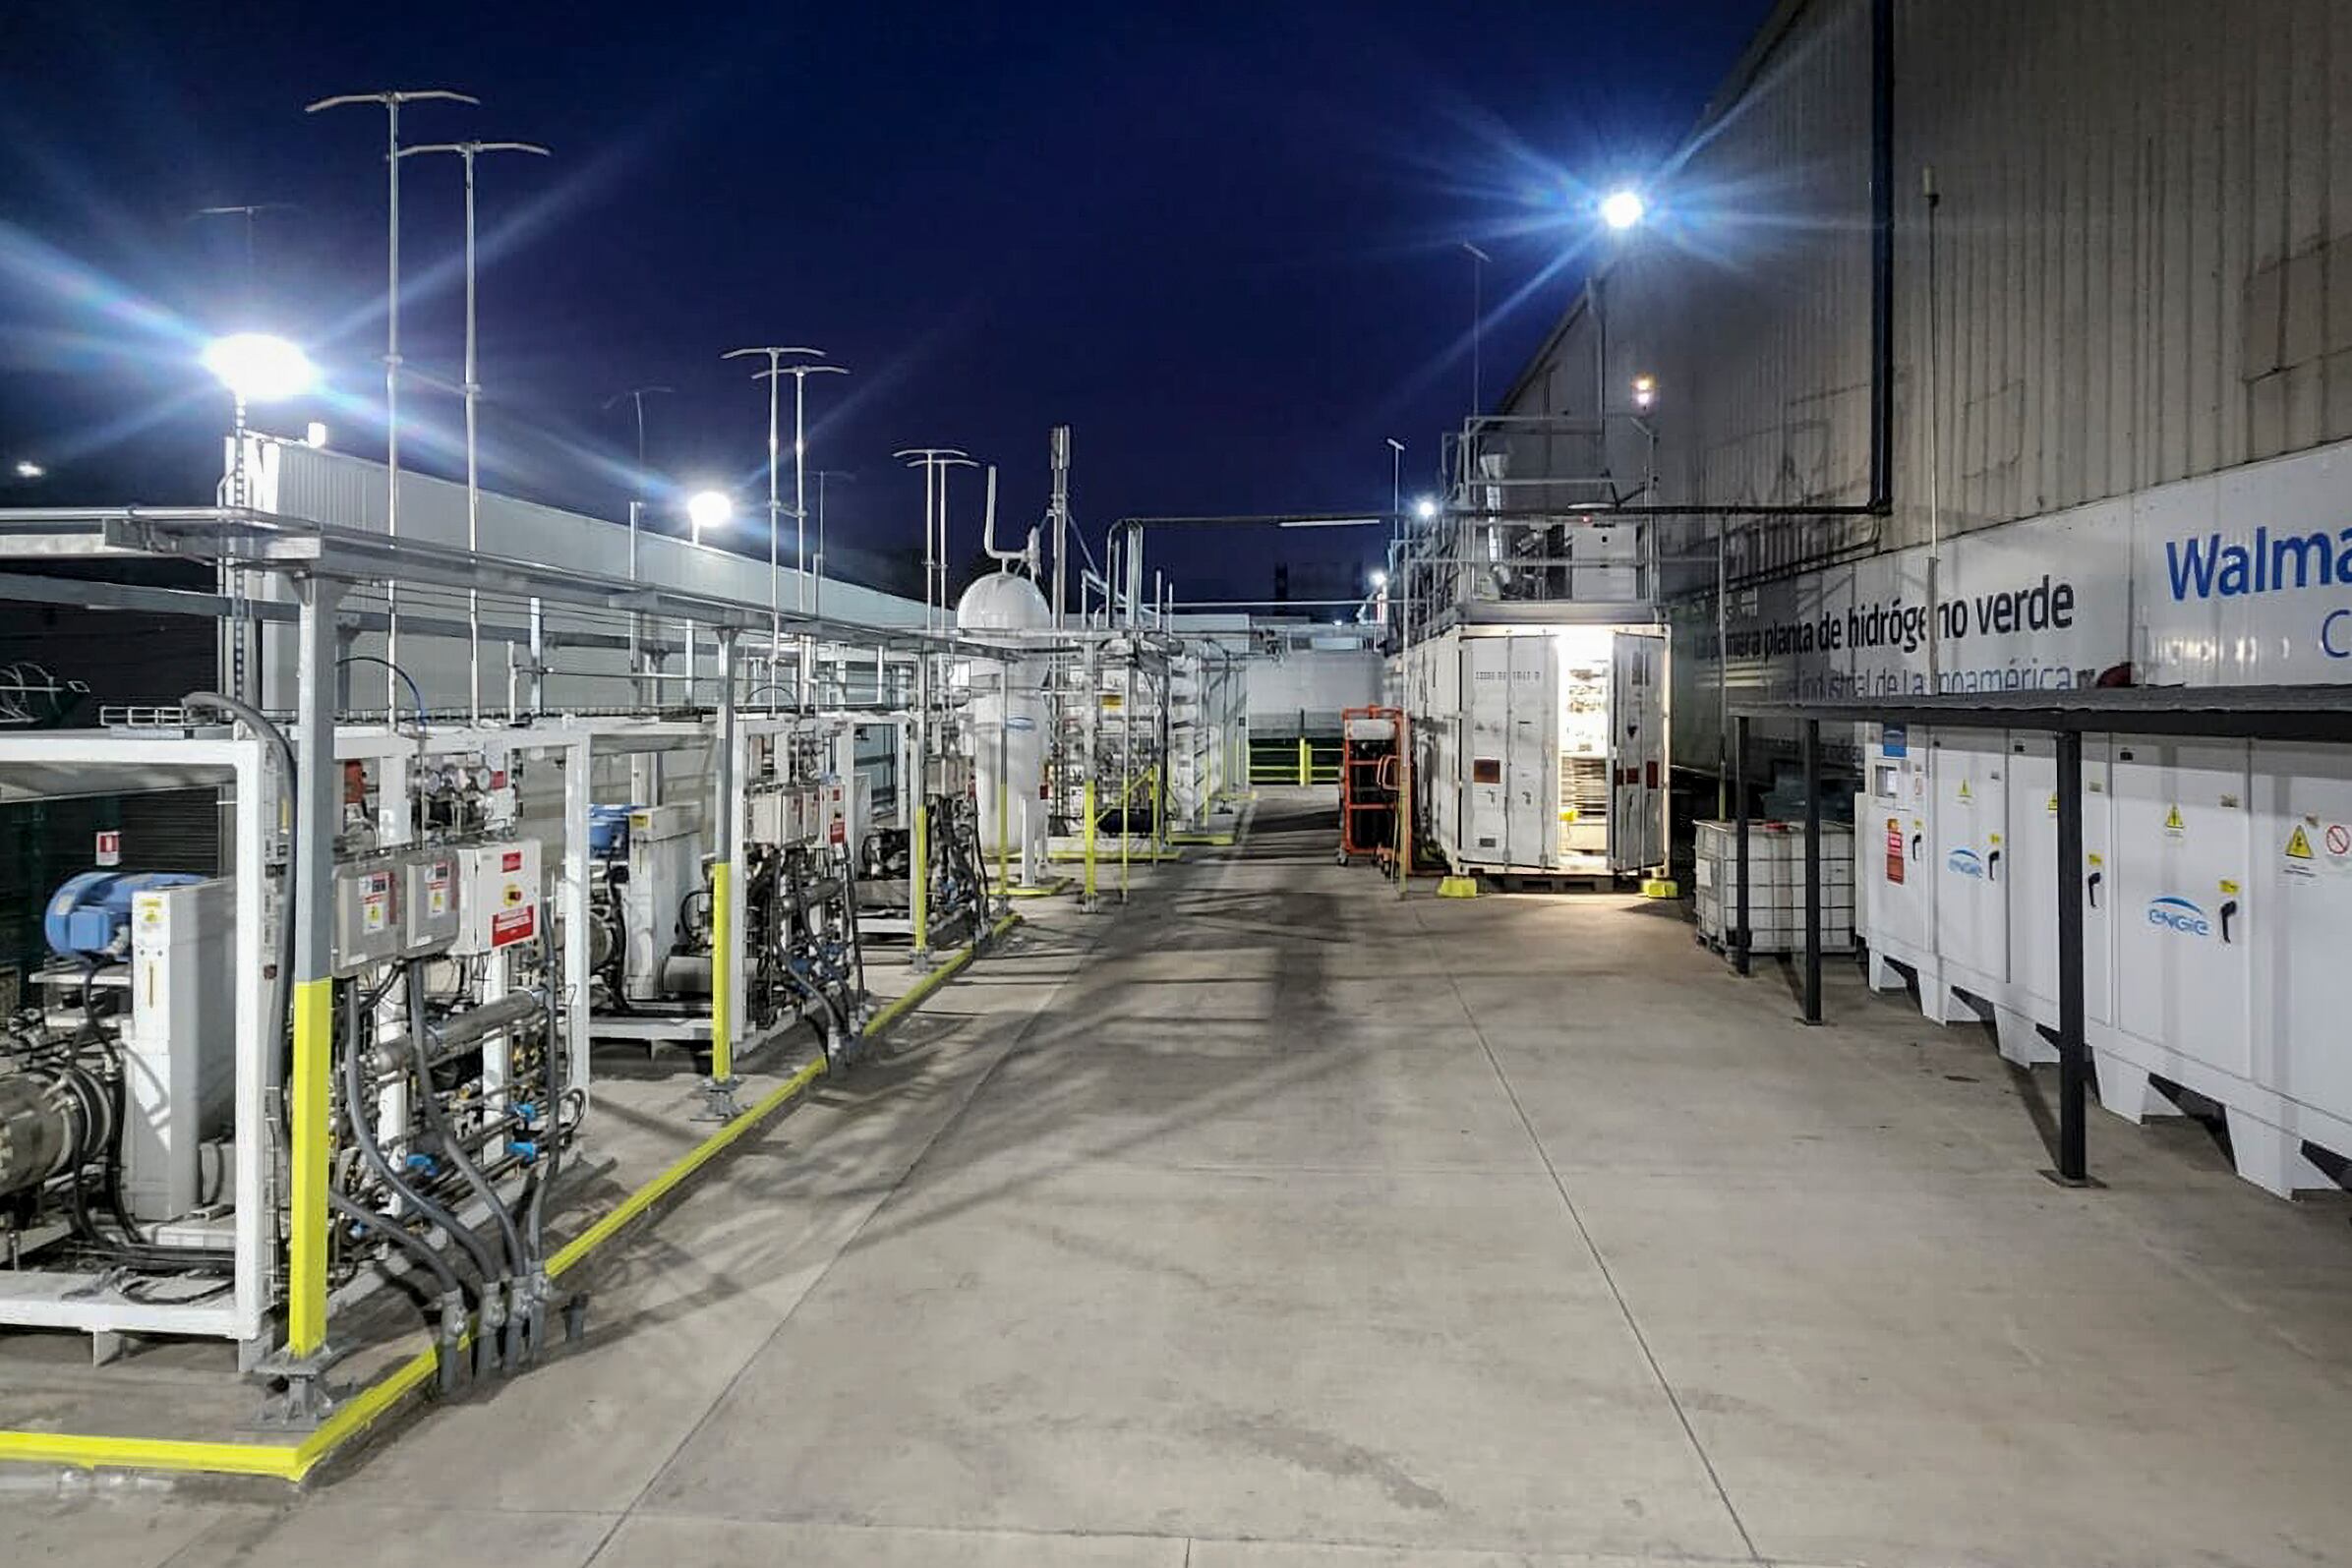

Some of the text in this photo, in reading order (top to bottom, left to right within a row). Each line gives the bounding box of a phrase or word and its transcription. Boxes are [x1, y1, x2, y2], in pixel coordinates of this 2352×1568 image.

[1765, 620, 1814, 665] planta
[1819, 611, 1842, 651] de
[1848, 598, 1969, 654] hidrógeno
[1976, 574, 2075, 636] verde
[1875, 668, 1898, 697] de
[1904, 658, 2072, 697] Lanoamérica
